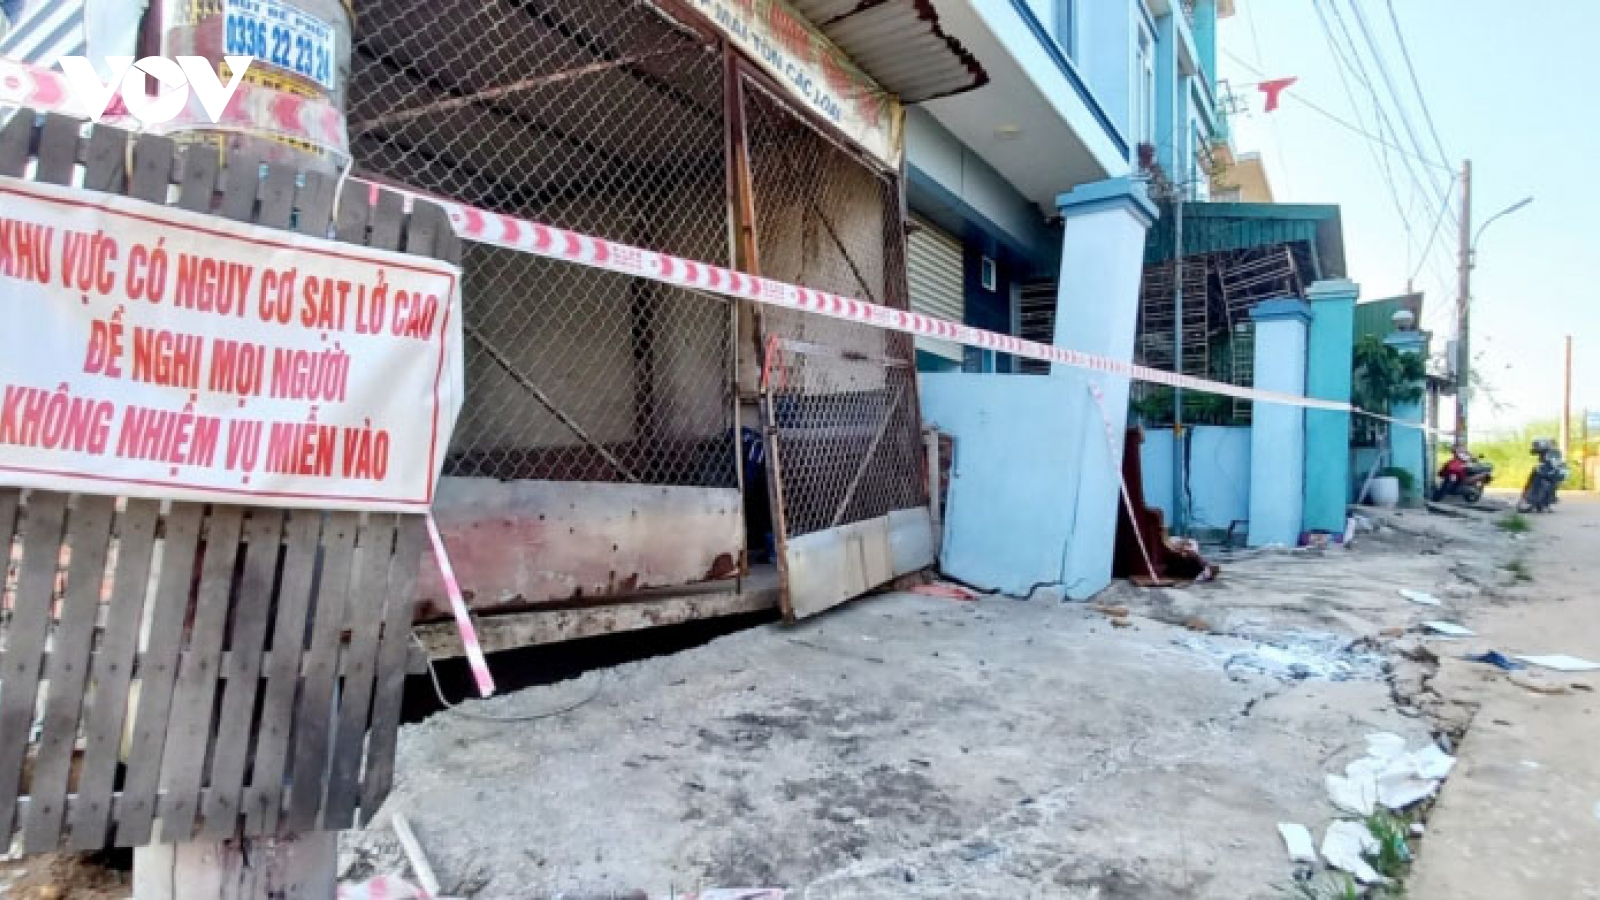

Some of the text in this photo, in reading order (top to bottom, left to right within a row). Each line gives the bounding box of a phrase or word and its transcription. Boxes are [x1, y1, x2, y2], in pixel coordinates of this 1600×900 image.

[272, 25, 290, 67] 22
[61, 229, 118, 303] VỰC
[125, 237, 168, 304] CÓ
[175, 253, 253, 317] NGUY
[259, 268, 298, 325] CƠ
[301, 275, 351, 341] SẠT
[356, 269, 389, 334] LỞ
[391, 289, 439, 341] CAO
[132, 326, 203, 401] NGHỊ
[208, 338, 267, 407] MỌI
[270, 341, 351, 402] NGƯỜI
[2, 382, 114, 455] KHÔNG
[116, 393, 220, 476] NHIỆM
[225, 418, 263, 484] VỤ
[341, 417, 390, 481] VÀO
